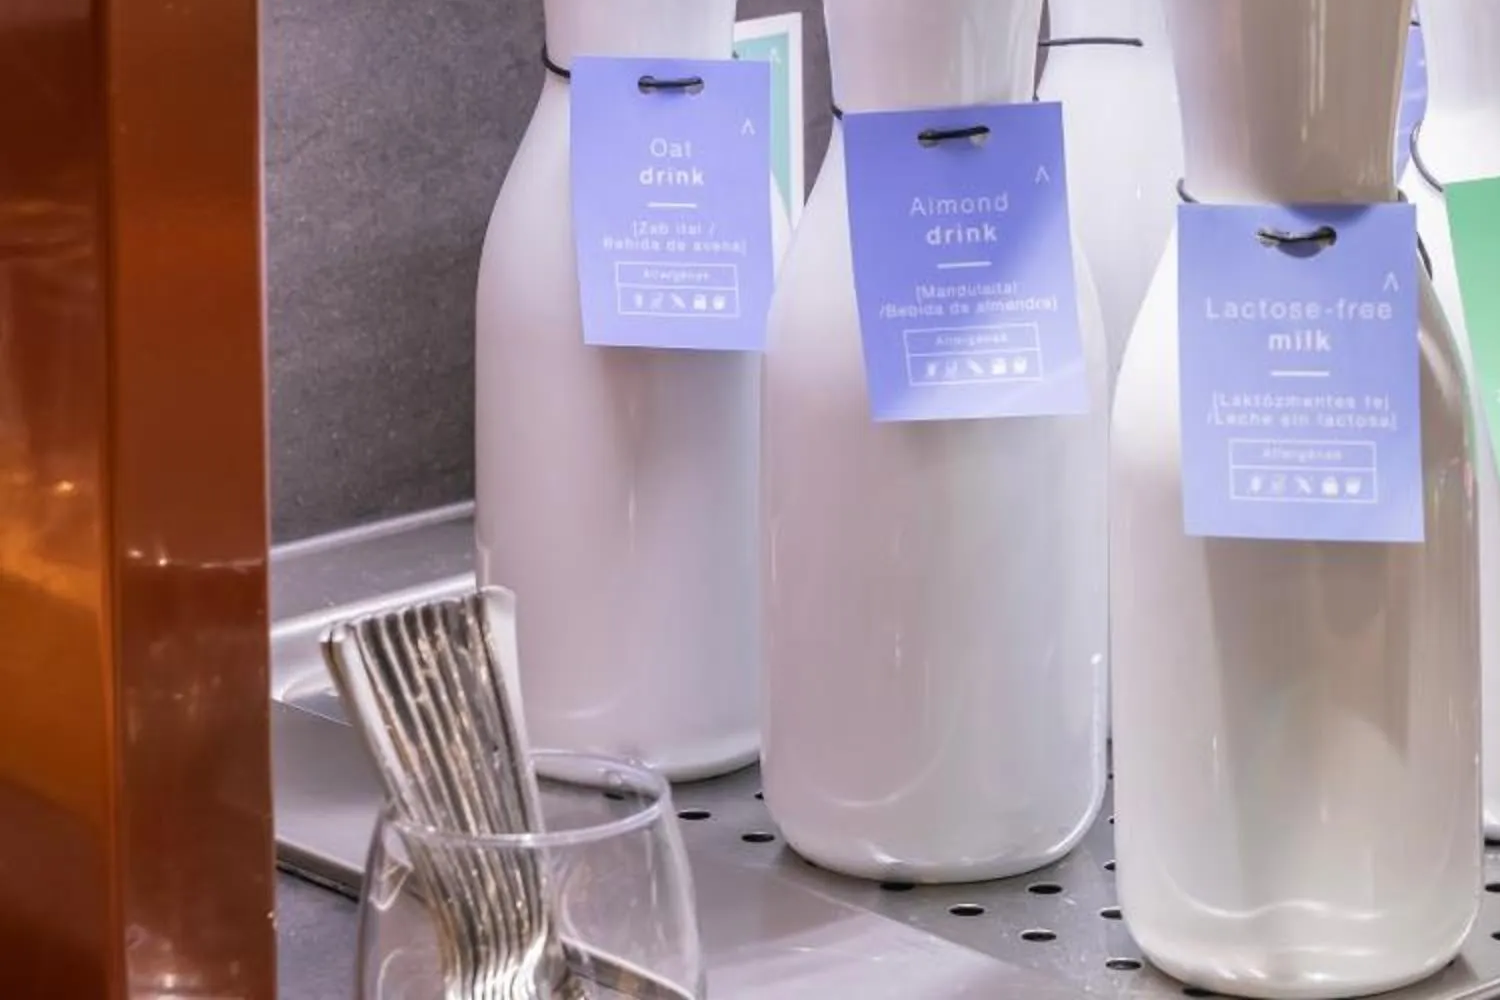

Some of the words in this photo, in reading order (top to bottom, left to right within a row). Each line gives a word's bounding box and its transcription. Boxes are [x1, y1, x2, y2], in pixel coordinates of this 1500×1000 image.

[650, 137, 692, 158] Oat
[639, 166, 705, 185] drink
[909, 191, 1009, 217] Almond
[926, 223, 998, 245] drink
[1205, 296, 1393, 320] Lactose-free
[1268, 329, 1332, 352] milk
